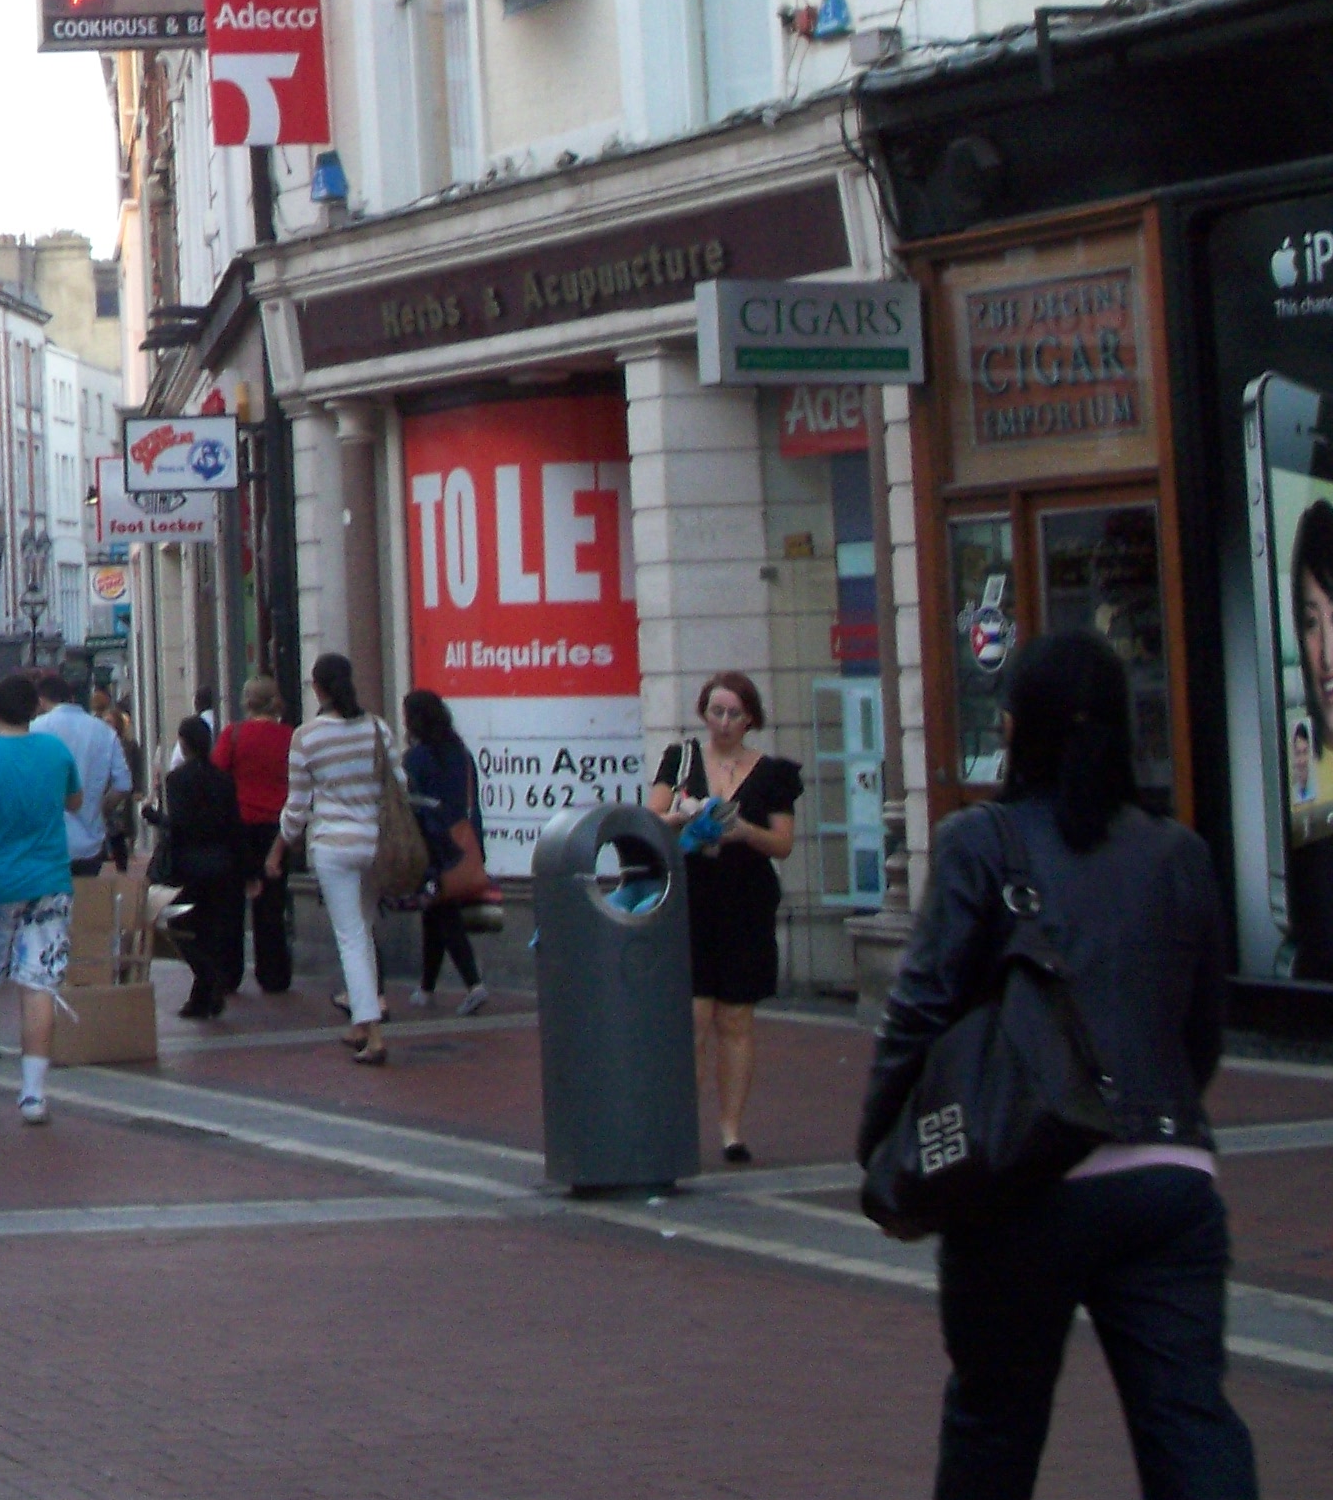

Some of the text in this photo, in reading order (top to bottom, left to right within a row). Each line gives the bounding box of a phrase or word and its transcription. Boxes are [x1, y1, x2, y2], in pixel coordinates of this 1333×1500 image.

[53, 17, 158, 39] COOKHOUSE
[166, 16, 179, 34] &
[214, 1, 319, 31] Adecco
[381, 293, 461, 338] Herbs
[523, 239, 725, 310] Acupuncture
[740, 298, 902, 336] CIGARS
[979, 328, 1127, 394] CIGAR
[983, 393, 1135, 437] EMPORIUM
[150, 517, 203, 534] Locker
[412, 468, 479, 609] TO
[445, 639, 614, 673] All Enquiries
[478, 747, 645, 784] Quinn Agne
[526, 785, 574, 809] 662
